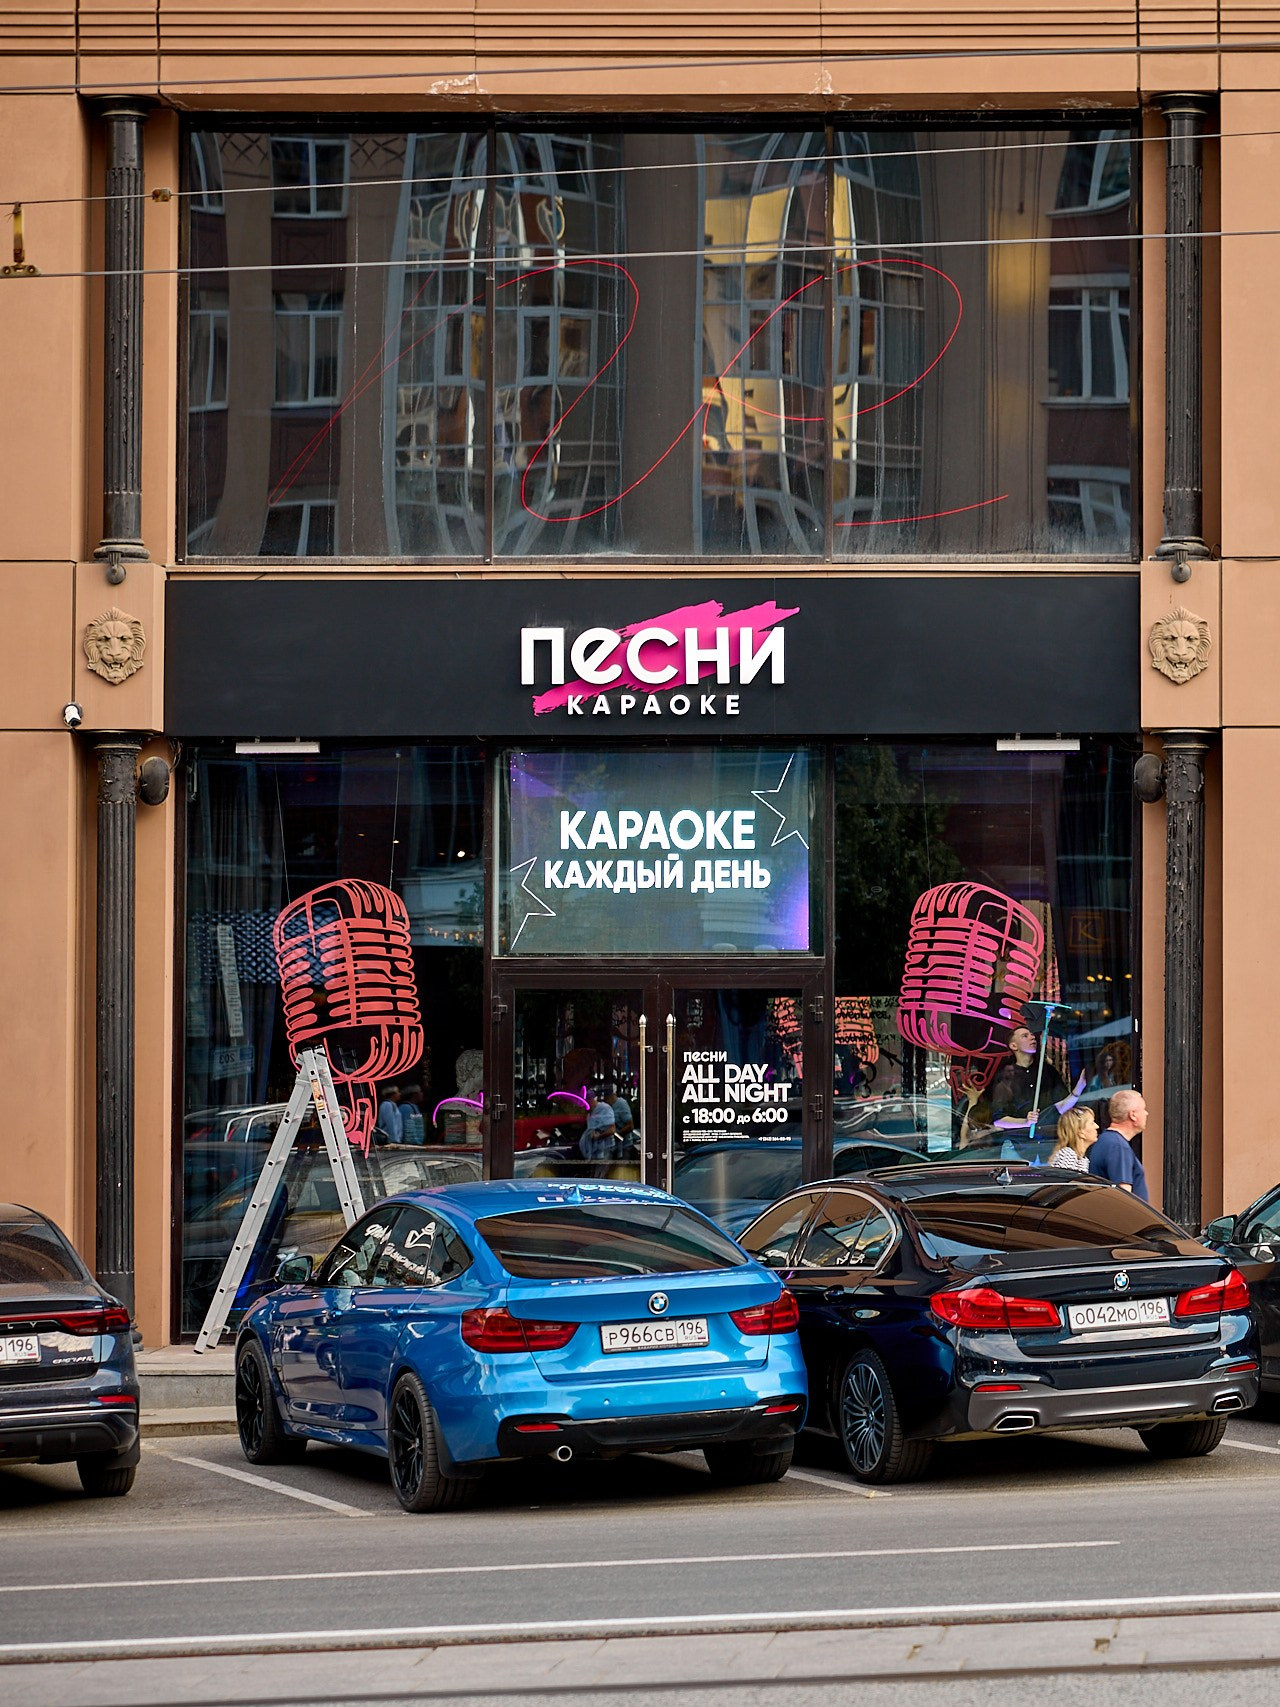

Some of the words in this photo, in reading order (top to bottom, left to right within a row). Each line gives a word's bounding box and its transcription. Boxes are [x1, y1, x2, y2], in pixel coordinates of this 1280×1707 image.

[567, 694, 740, 715] КАРАОКЕ
[560, 810, 755, 850] КАРАОКЕ
[544, 854, 684, 893] КАЖДЫЙ
[690, 860, 771, 893] ДЕНЬ
[681, 1064, 721, 1083] ALL
[724, 1064, 768, 1083] DAY
[681, 1083, 720, 1103] ALL
[724, 1083, 792, 1103] NIGHT
[691, 1108, 735, 1124] 18:00
[736, 1115, 751, 1125] до
[752, 1108, 788, 1124] 6:00
[1140, 1302, 1163, 1315] 196
[609, 1326, 675, 1346] Р966СВ
[678, 1321, 703, 1336] 196
[8, 1338, 33, 1352] 196
